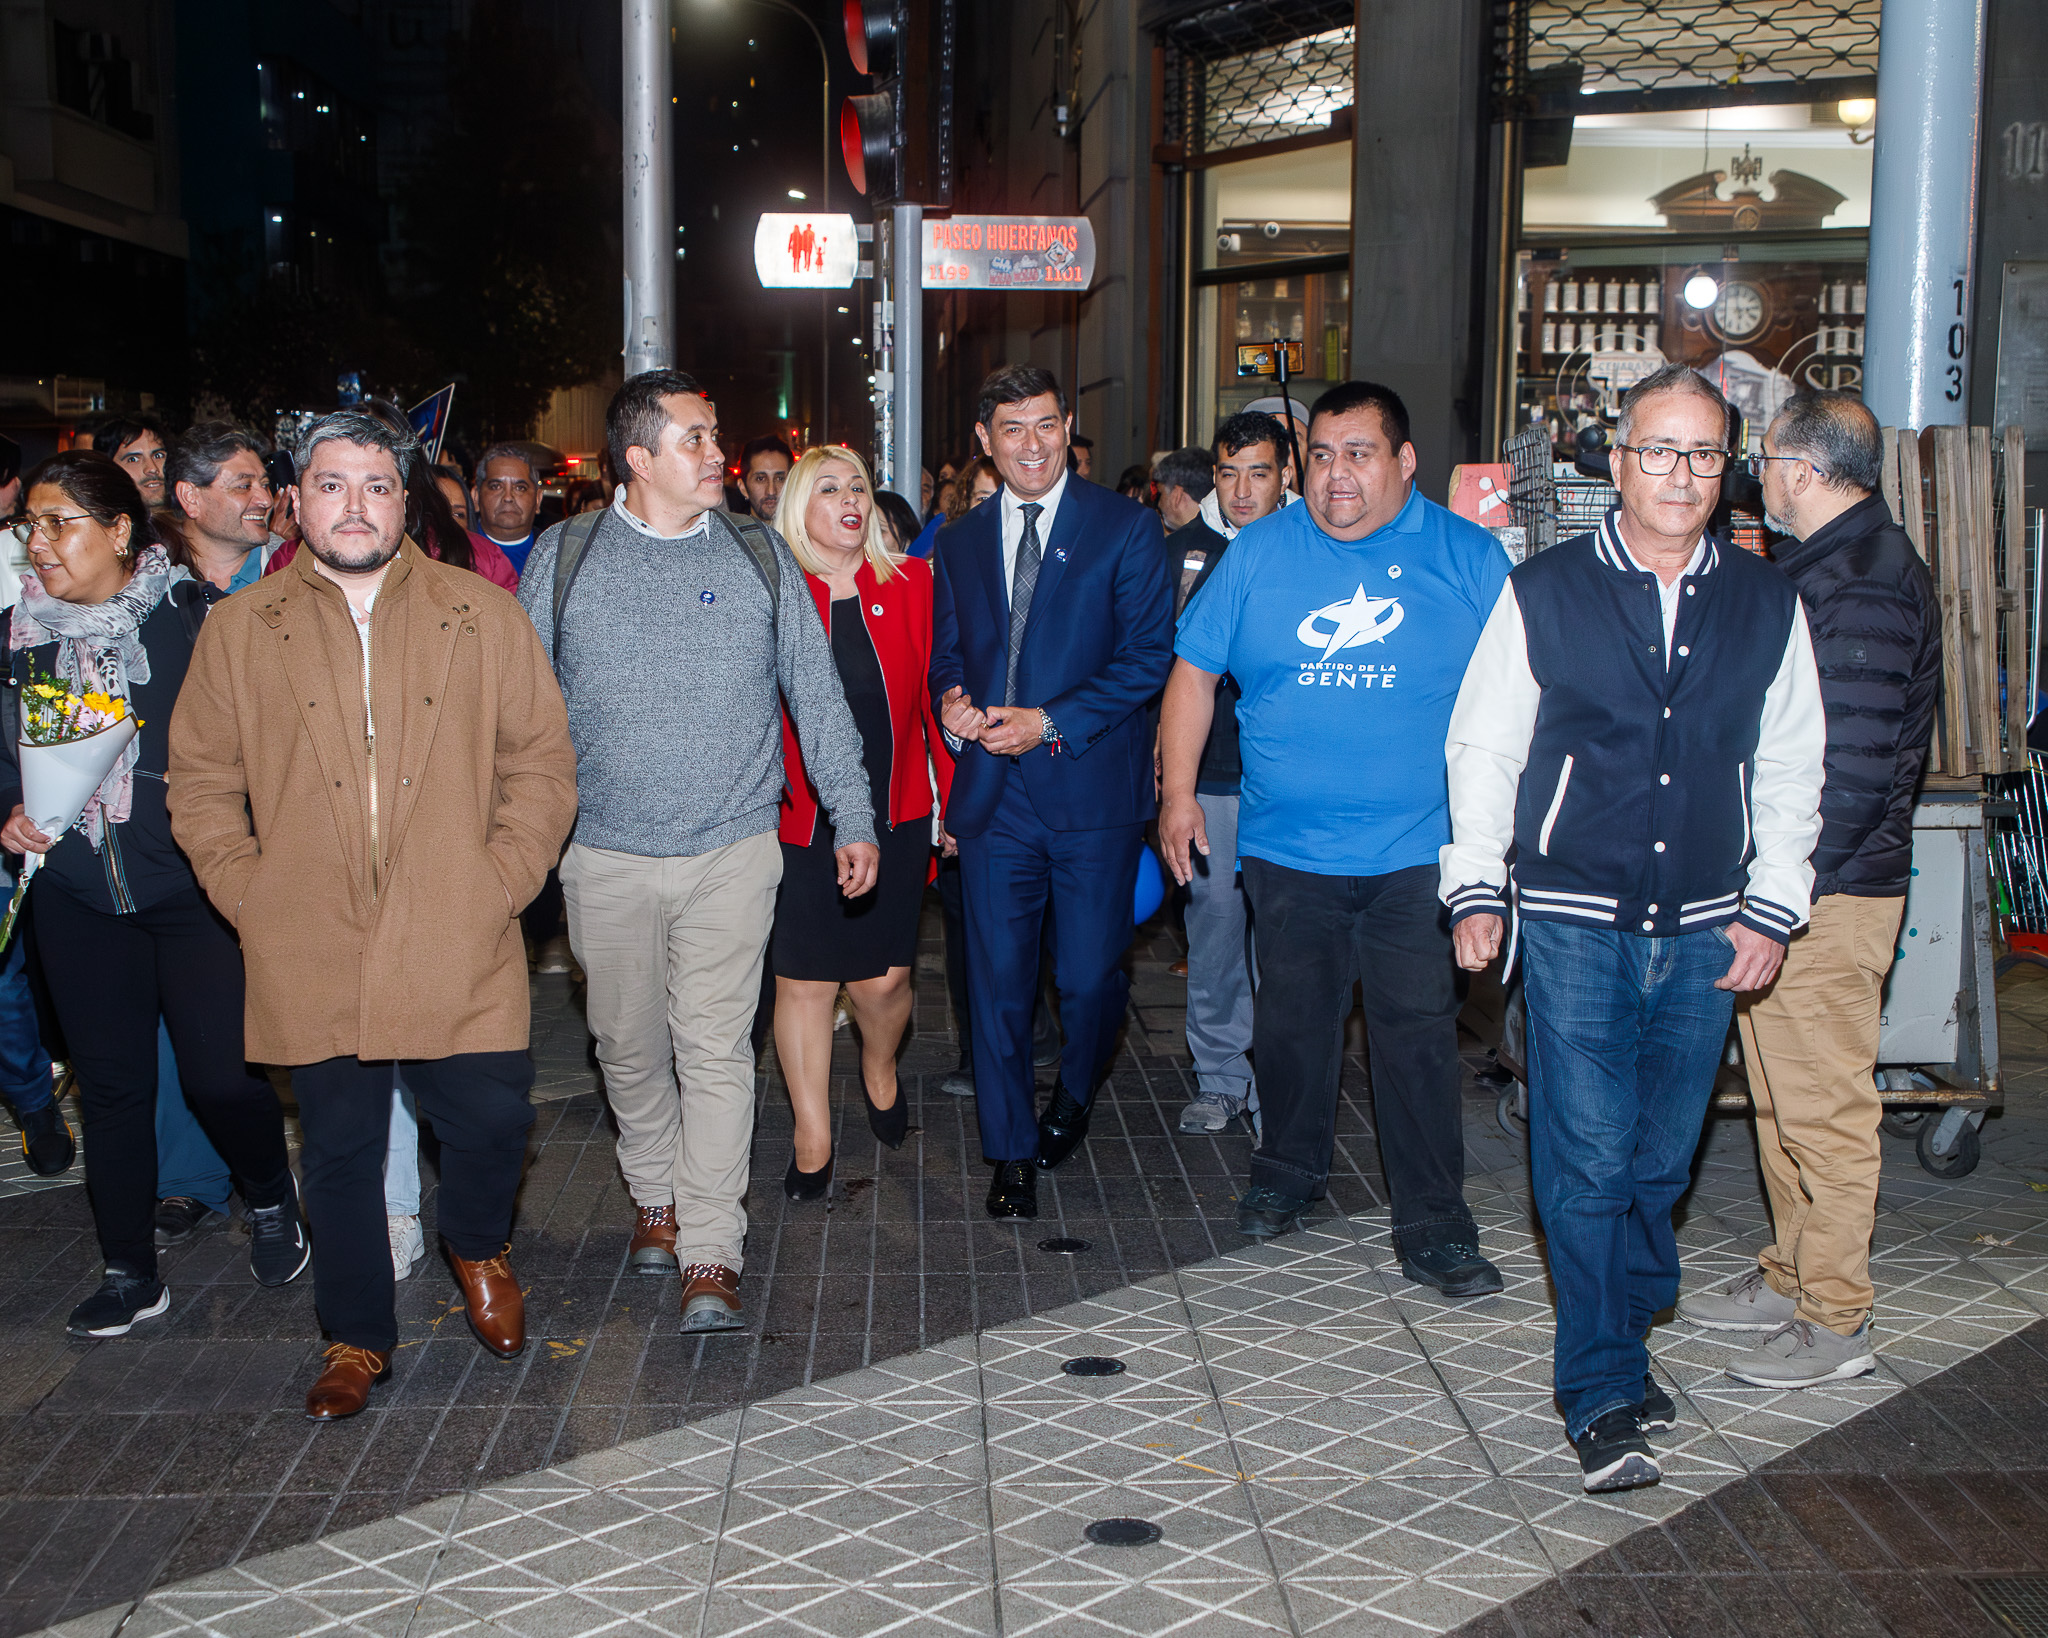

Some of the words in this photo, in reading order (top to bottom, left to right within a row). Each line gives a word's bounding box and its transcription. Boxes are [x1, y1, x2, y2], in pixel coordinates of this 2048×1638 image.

[933, 223, 982, 250] PASEO
[986, 224, 1078, 252] HUERFANOS
[929, 263, 970, 281] 1199
[1044, 265, 1083, 282] 1101
[1945, 279, 1965, 402] 103
[1300, 662, 1354, 671] PARTIDO
[1358, 664, 1375, 672] DE
[1380, 664, 1397, 672] LA
[1297, 671, 1396, 689] GENTE
